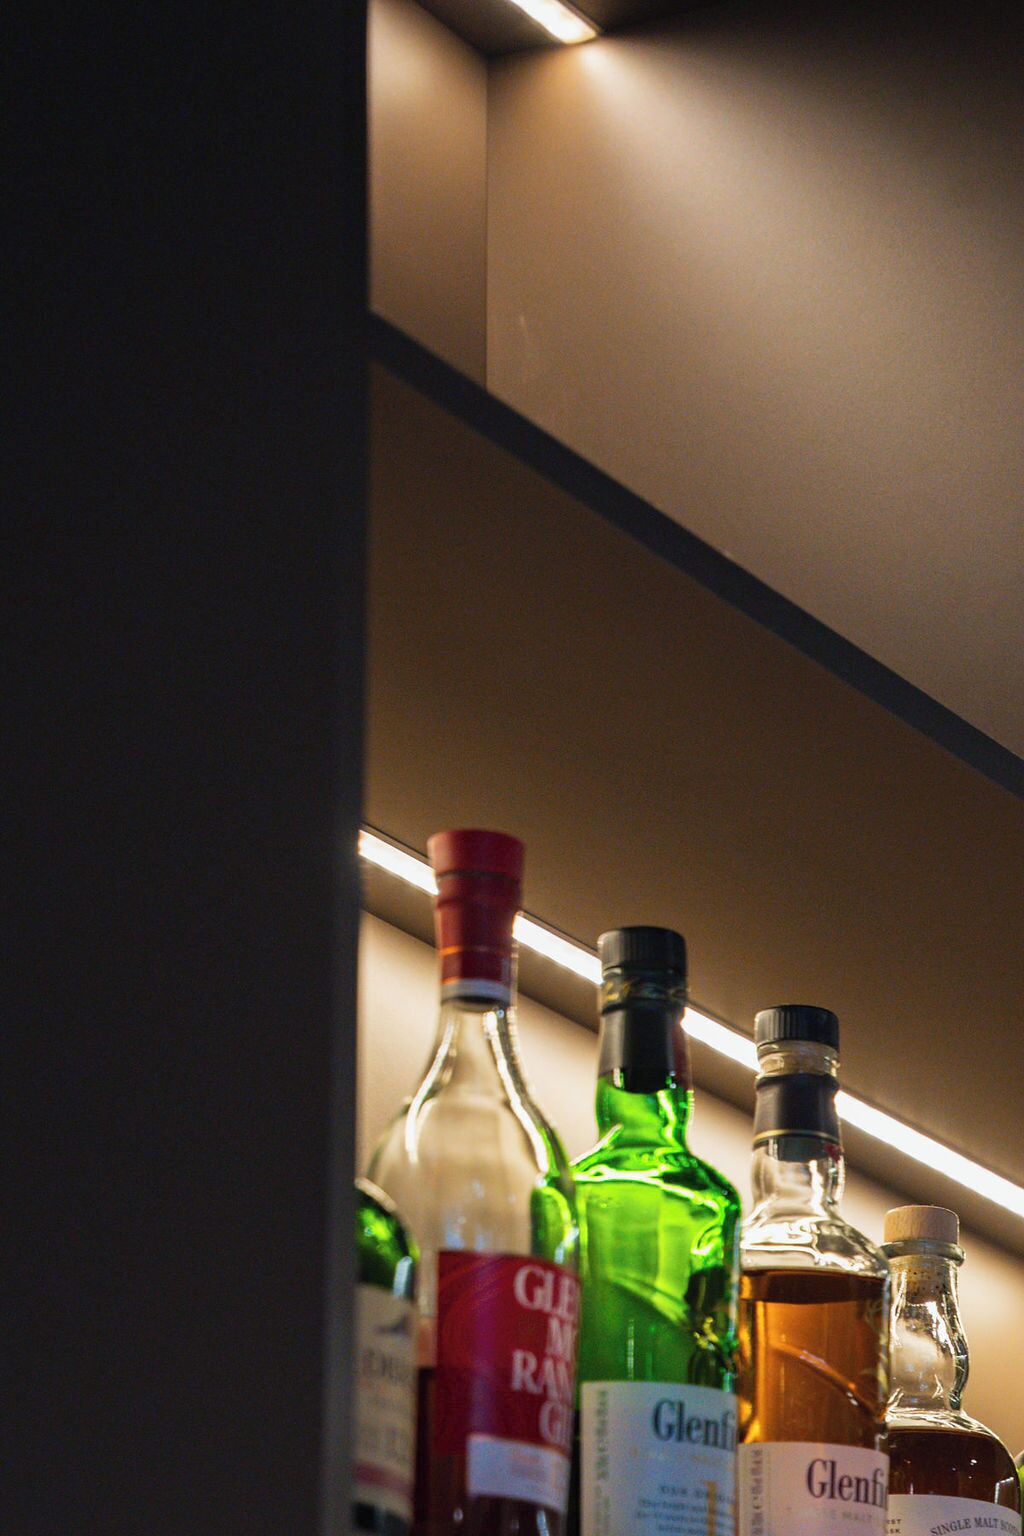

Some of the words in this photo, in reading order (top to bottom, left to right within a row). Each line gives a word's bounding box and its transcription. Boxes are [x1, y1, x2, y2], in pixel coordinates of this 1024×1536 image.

[514, 1265, 581, 1320] GLE
[807, 1458, 888, 1512] Glenfi
[974, 1516, 998, 1529] MALT
